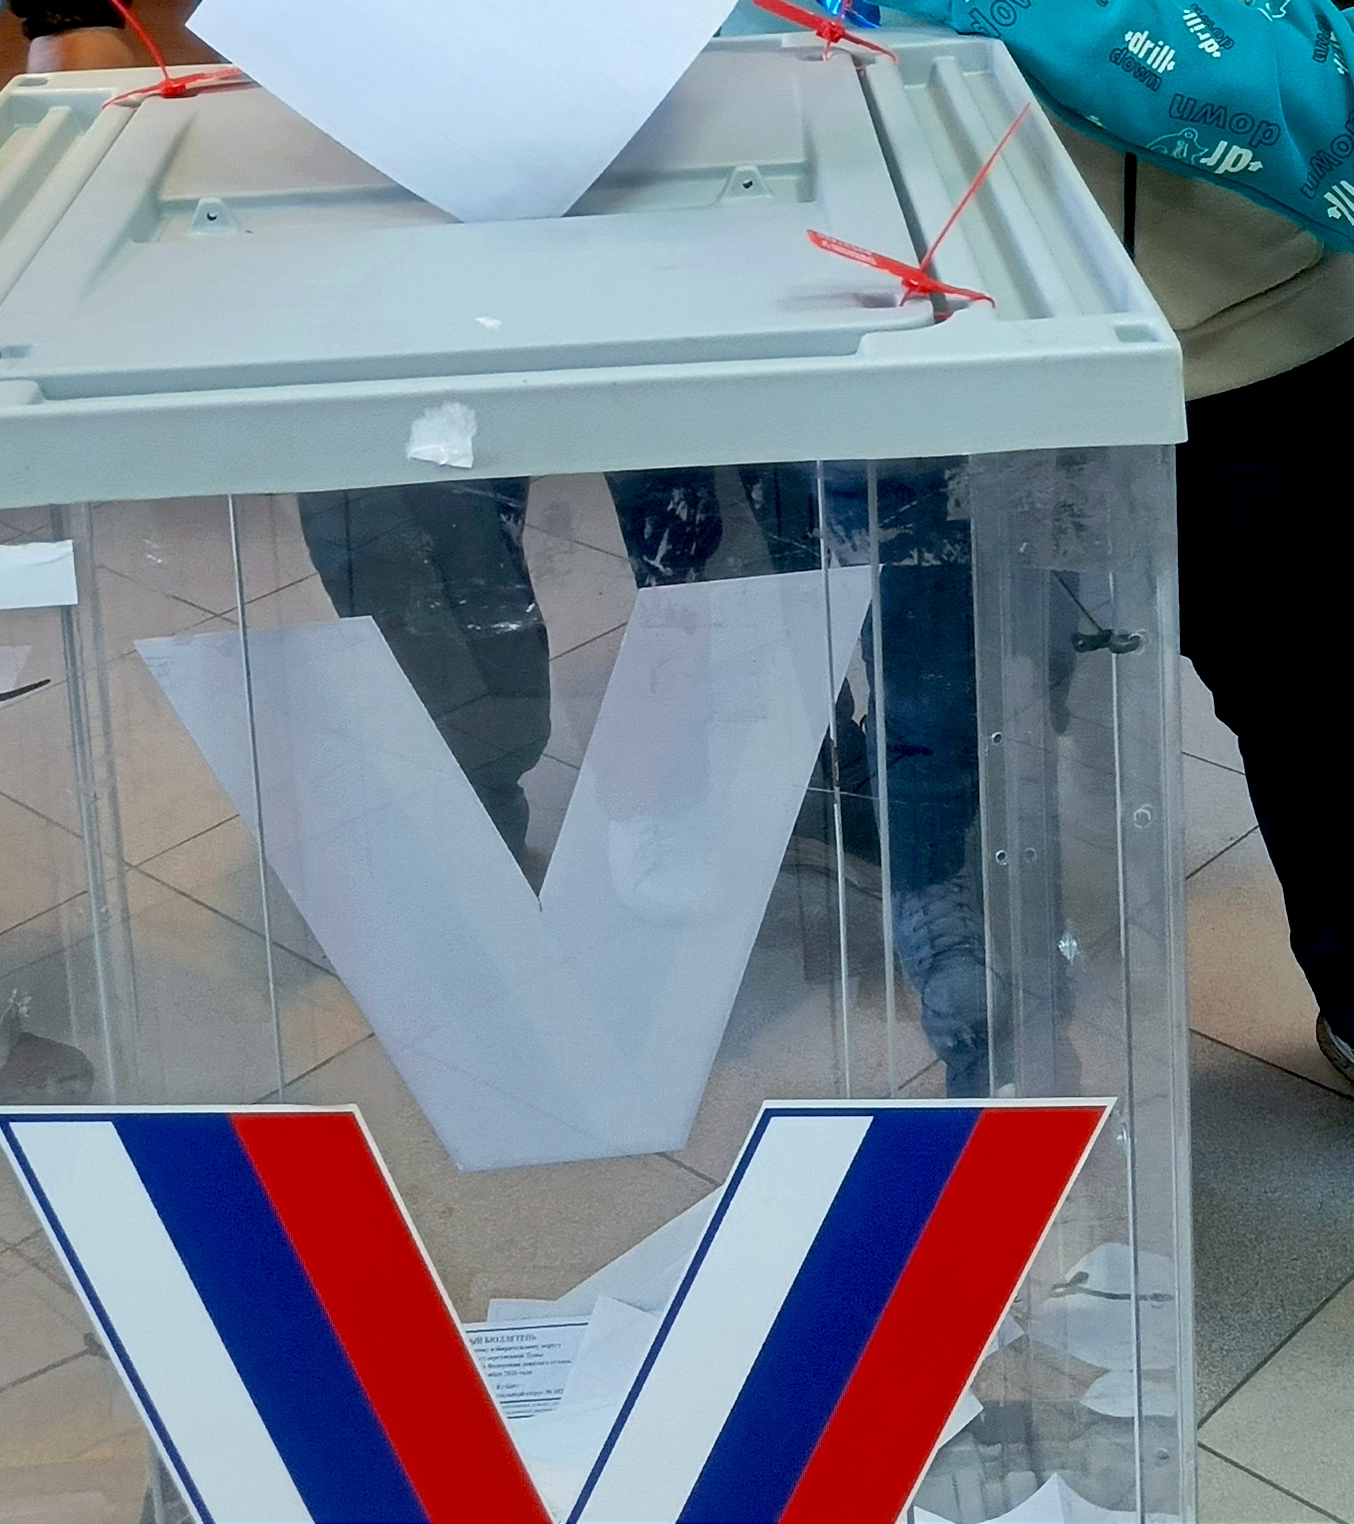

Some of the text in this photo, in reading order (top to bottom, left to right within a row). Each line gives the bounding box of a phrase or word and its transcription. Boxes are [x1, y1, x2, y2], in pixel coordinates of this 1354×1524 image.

[1109, 47, 1163, 92] down
[1127, 31, 1176, 74] drill
[1168, 93, 1281, 148] down
